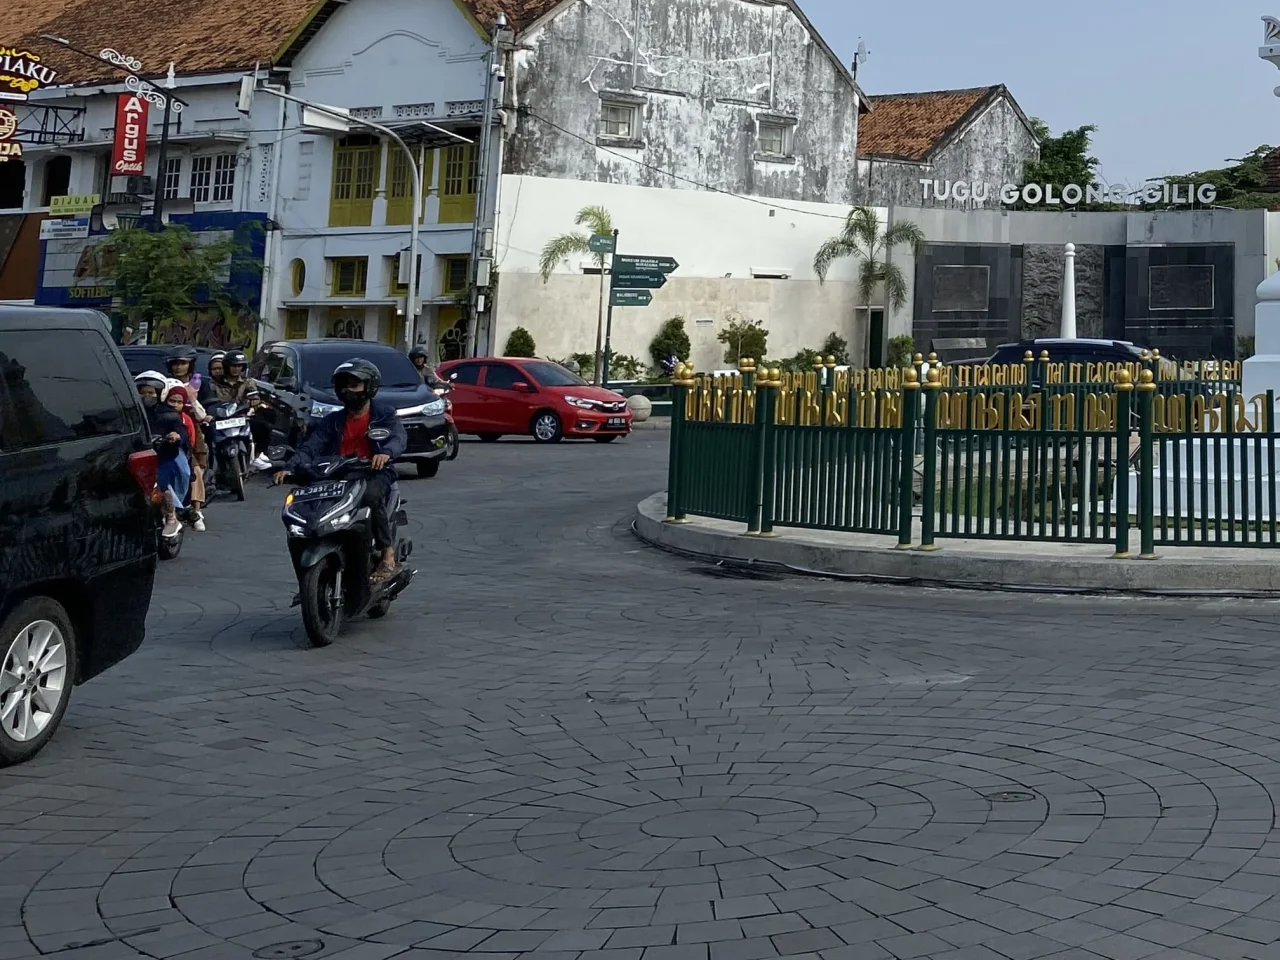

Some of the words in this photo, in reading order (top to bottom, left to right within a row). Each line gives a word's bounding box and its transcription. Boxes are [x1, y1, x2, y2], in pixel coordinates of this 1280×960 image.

[123, 97, 143, 161] Argus
[0, 143, 22, 156] JA
[53, 196, 97, 207] DIJUAL
[919, 179, 989, 201] TUGU
[1000, 183, 1128, 205] GOLONG
[1142, 183, 1217, 204] GILIG
